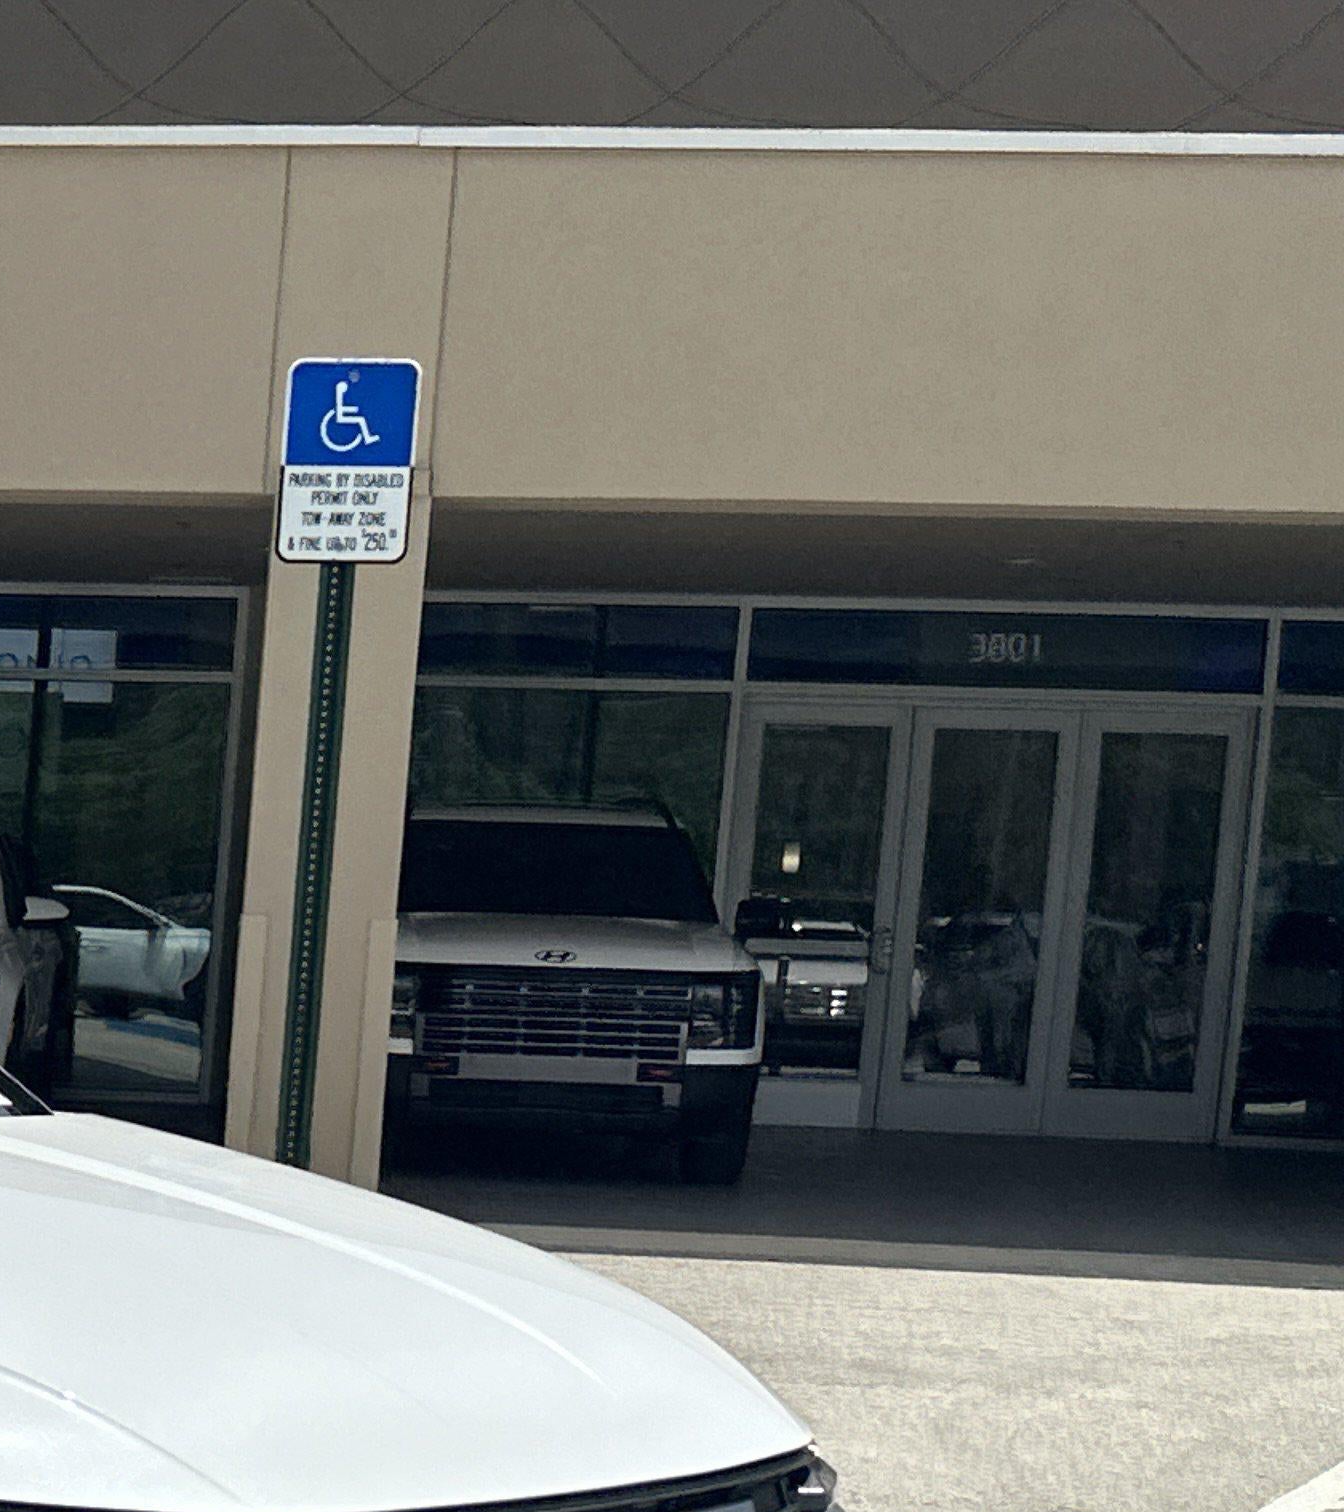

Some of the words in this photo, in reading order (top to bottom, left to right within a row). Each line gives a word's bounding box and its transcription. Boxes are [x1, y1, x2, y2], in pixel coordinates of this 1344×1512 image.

[288, 473, 332, 488] PARKING
[336, 473, 350, 488] BY
[353, 473, 404, 489] DISABLED
[310, 490, 348, 505] PERMIT
[352, 490, 379, 505] ONLY
[358, 511, 386, 526] ZONE
[288, 537, 294, 551] &
[299, 536, 321, 551] FINE
